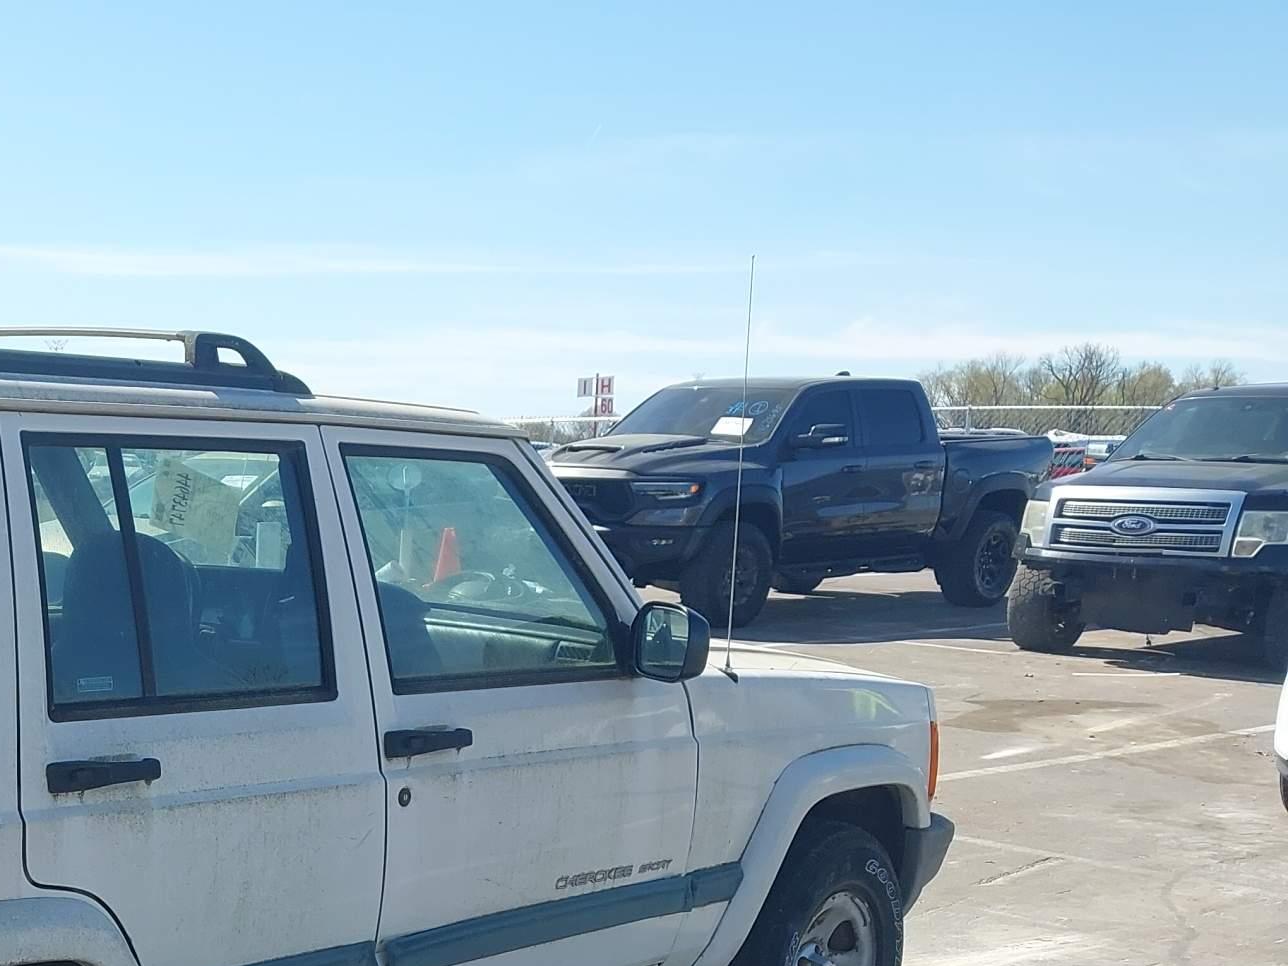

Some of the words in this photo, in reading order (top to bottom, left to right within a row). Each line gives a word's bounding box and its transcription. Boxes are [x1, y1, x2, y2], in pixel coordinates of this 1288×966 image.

[601, 377, 612, 394] H
[601, 398, 614, 414] 60
[555, 864, 634, 890] CHEROKEE
[637, 859, 673, 874] SPORT
